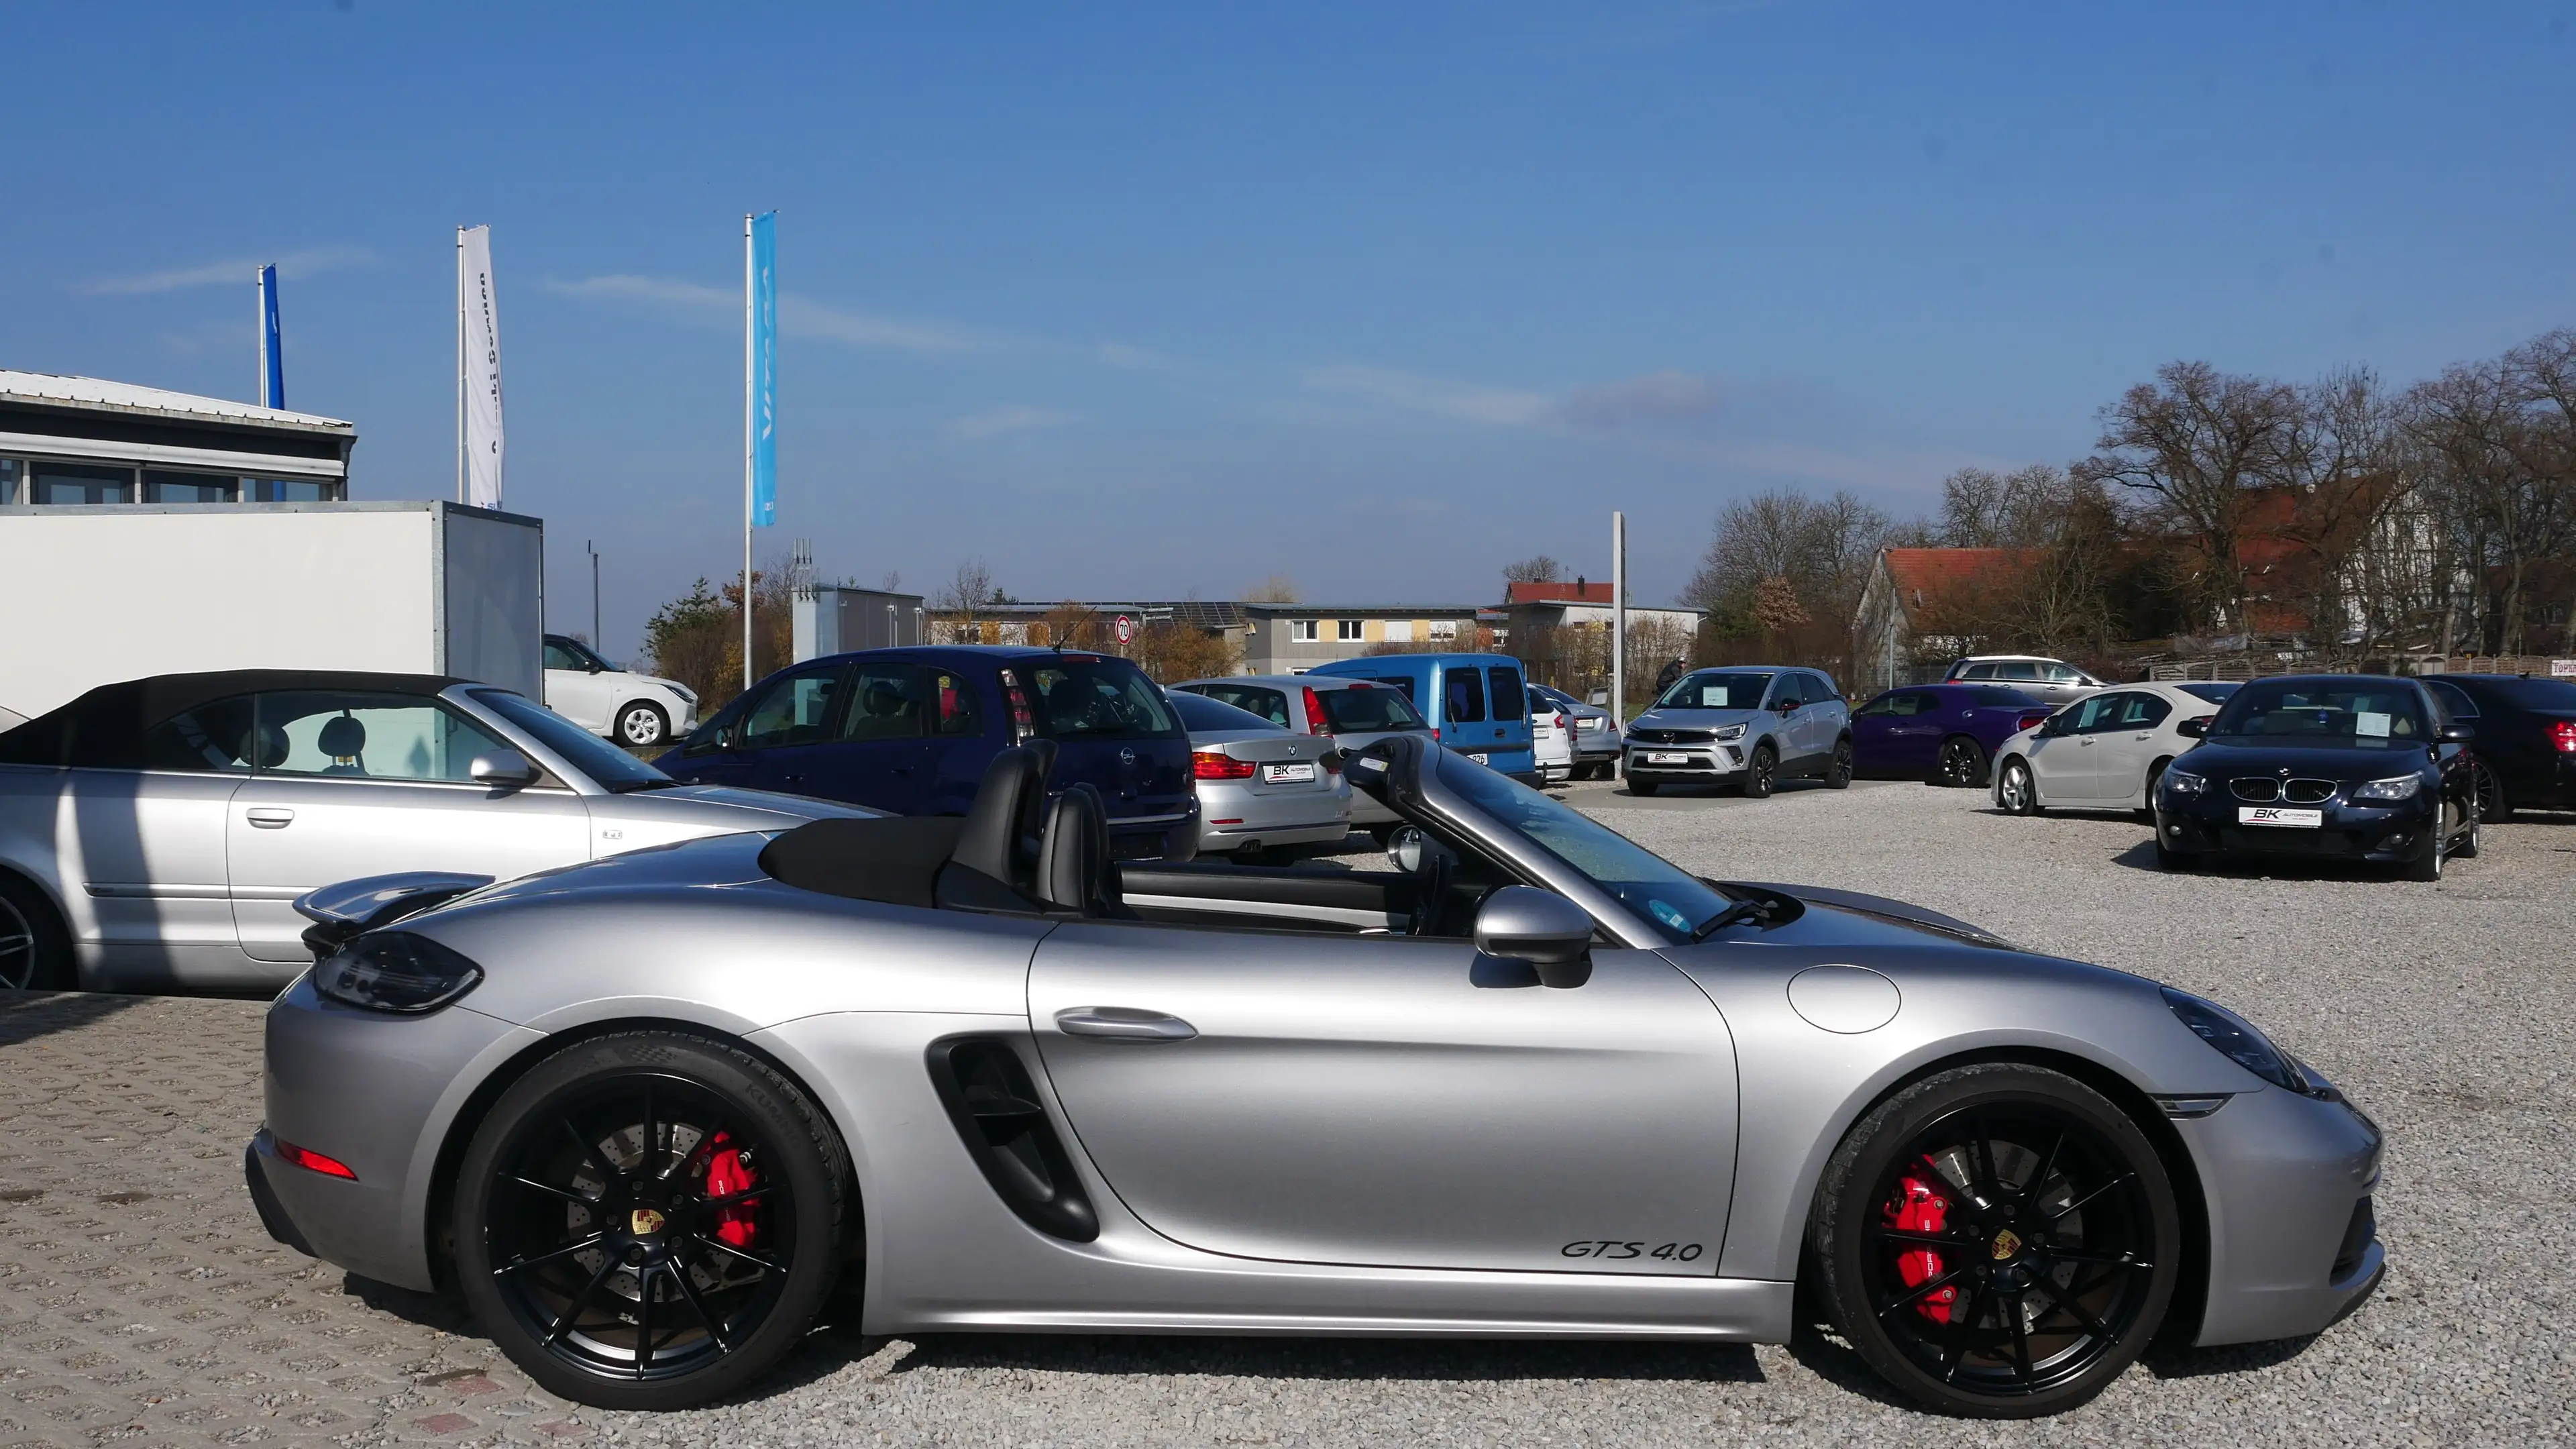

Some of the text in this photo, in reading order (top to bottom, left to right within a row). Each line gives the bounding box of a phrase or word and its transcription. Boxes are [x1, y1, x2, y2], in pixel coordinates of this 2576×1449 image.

[1120, 624, 1128, 637] 70
[1273, 765, 1289, 775] BK
[2253, 809, 2282, 819] BK
[1561, 1241, 1703, 1262] GTS 4.0
